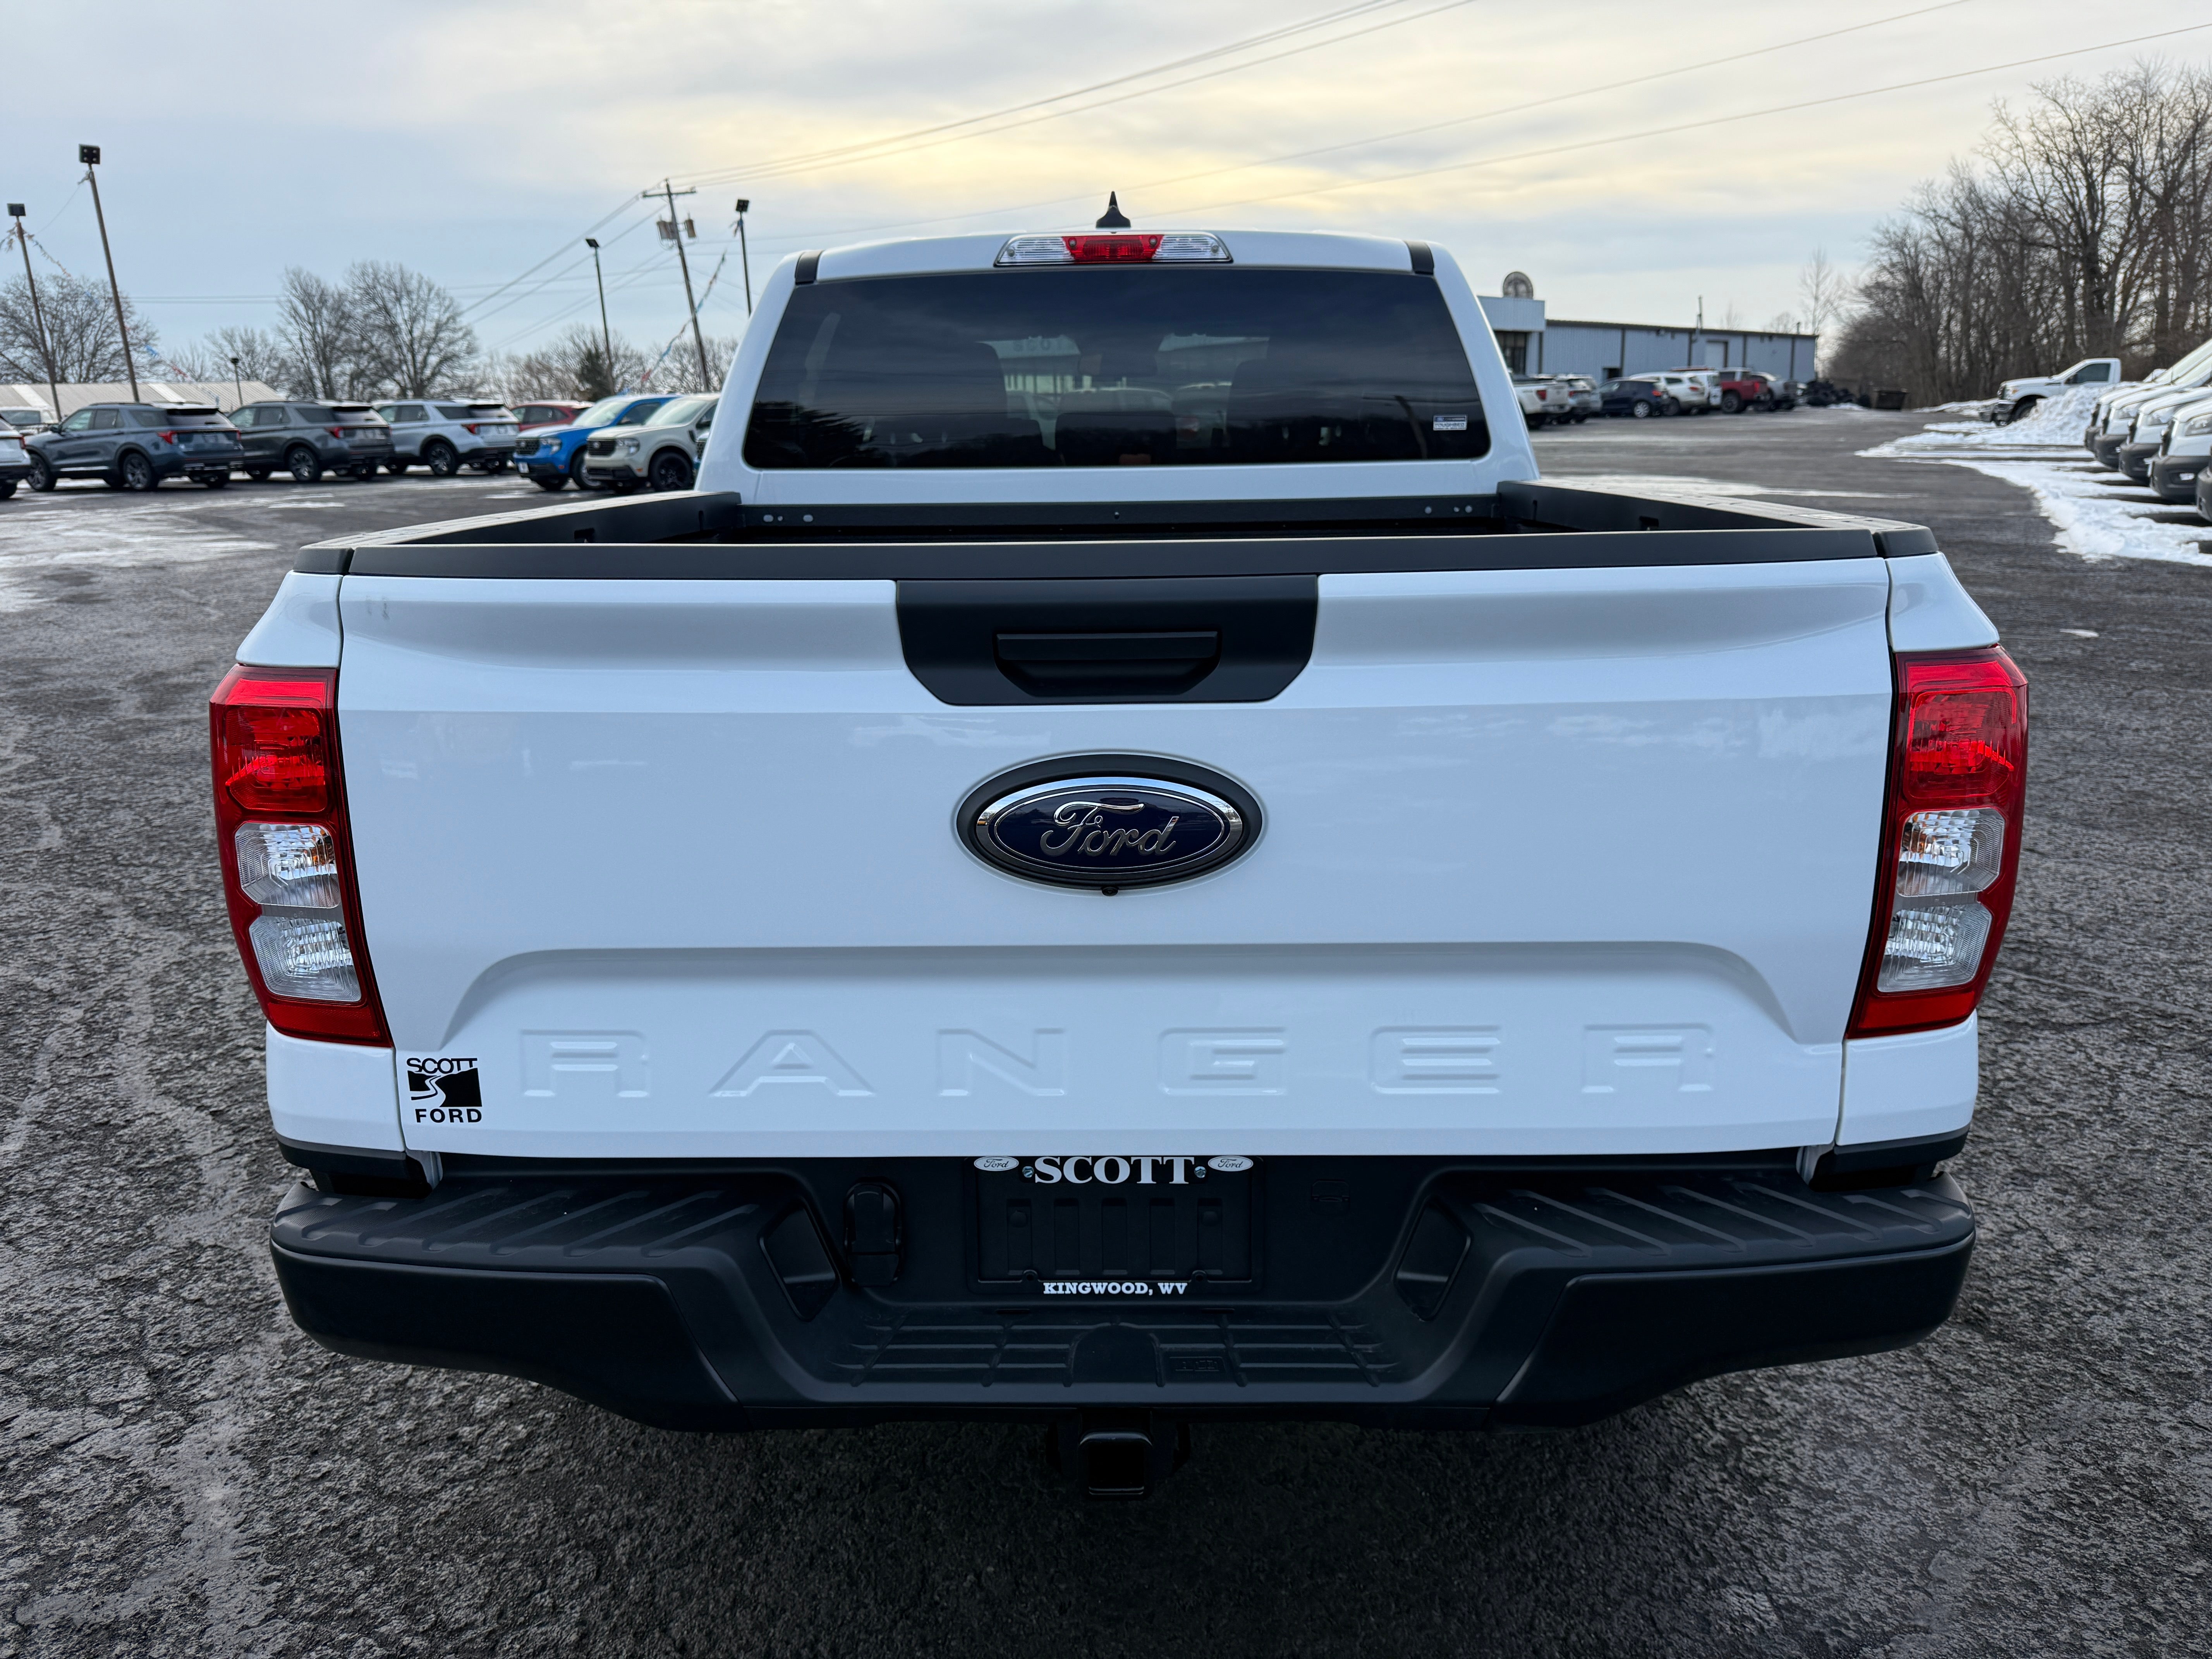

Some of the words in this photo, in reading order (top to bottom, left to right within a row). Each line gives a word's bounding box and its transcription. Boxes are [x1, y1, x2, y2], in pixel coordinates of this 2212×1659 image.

[1040, 801, 1180, 856] Ford
[407, 1058, 477, 1074] SCOTT
[518, 1024, 1714, 1097] RANGER
[415, 1108, 482, 1123] FORD
[984, 1159, 1009, 1168] Ford
[1035, 1156, 1195, 1184] SCOTT
[1218, 1159, 1243, 1168] Ford
[1043, 1282, 1153, 1296] KINGWOOD,
[1158, 1282, 1188, 1294] WV
